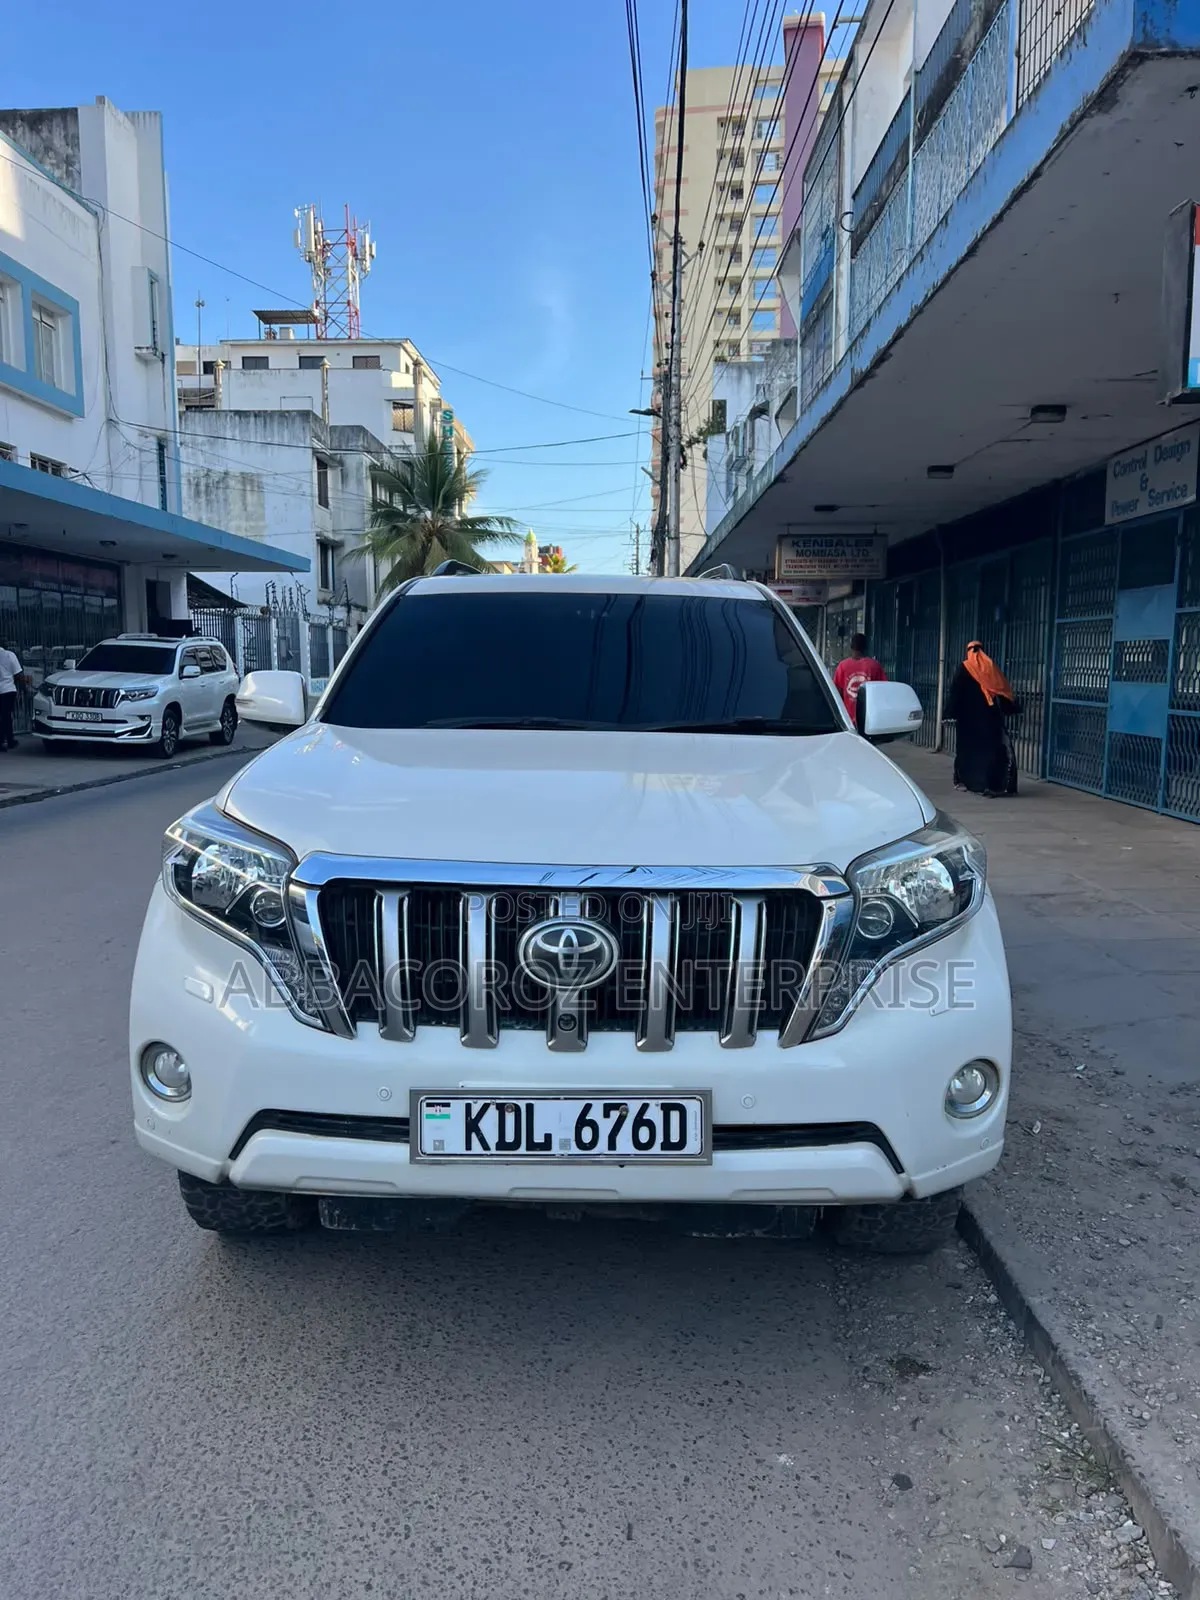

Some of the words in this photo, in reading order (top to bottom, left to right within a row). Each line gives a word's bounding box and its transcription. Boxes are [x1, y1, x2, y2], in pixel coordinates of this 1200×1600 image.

[1113, 449, 1148, 479] Control
[1154, 440, 1191, 465] Design
[1111, 498, 1140, 518] Power
[1147, 481, 1189, 507] Service
[1140, 472, 1149, 492] &
[795, 548, 847, 558] MOMBASA
[464, 1102, 553, 1152] KDL
[574, 1102, 688, 1152] 676D
